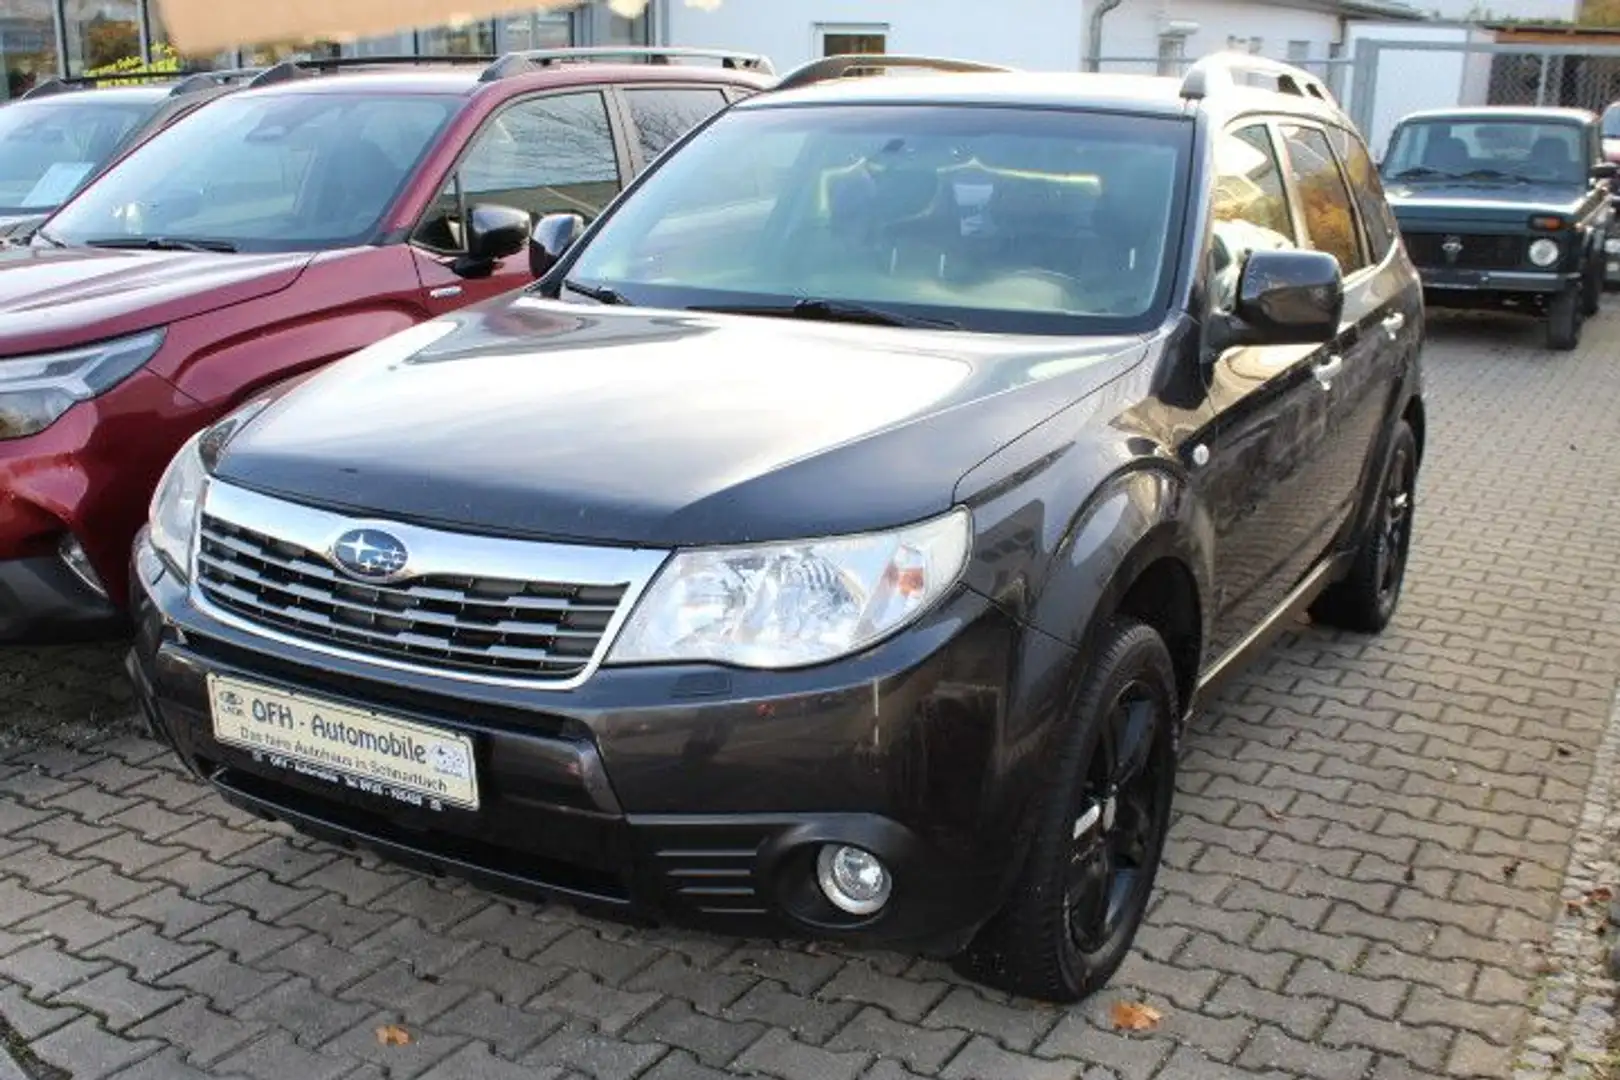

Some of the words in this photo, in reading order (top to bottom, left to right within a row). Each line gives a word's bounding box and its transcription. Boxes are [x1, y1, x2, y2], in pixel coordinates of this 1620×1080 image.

[252, 698, 294, 730] OFH
[311, 714, 427, 765] Automobile
[294, 740, 353, 768] Autohaus
[356, 756, 368, 770] in
